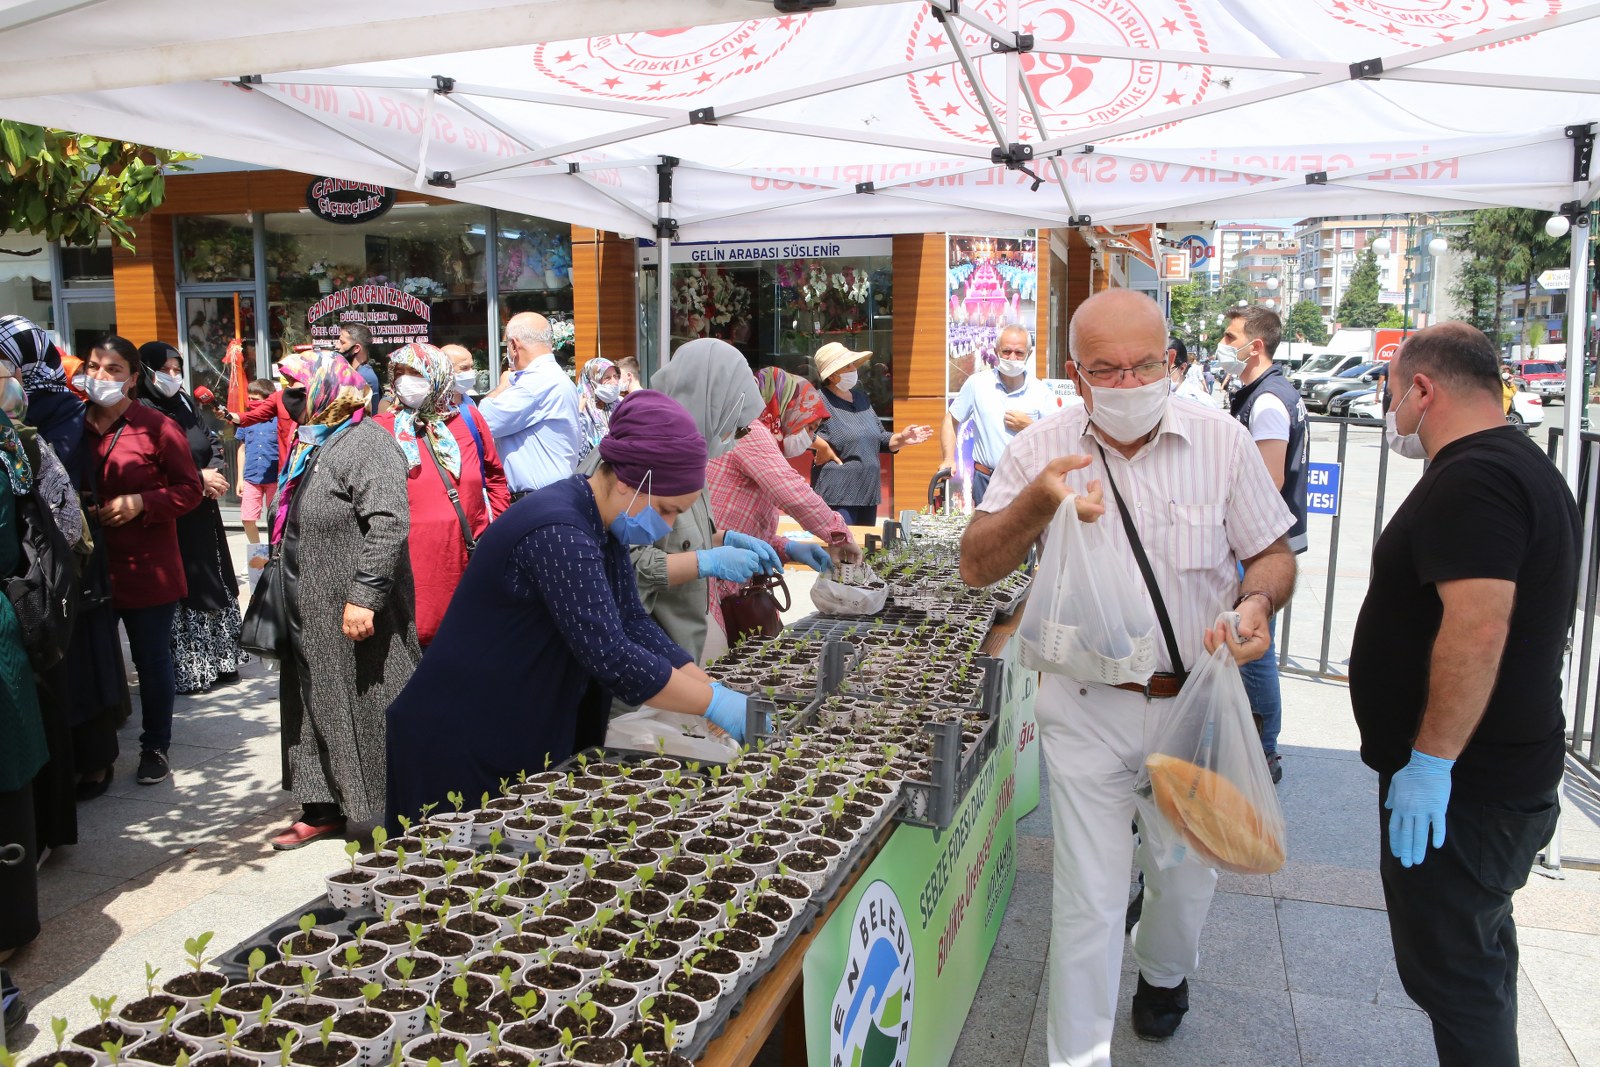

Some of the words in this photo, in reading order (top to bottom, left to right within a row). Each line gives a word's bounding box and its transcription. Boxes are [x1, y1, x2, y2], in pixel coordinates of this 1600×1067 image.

[312, 177, 386, 199] CANDAN
[318, 194, 381, 218] ÇİÇEKÇİLİK
[691, 246, 725, 262] GELİN
[729, 244, 780, 260] ARABASI
[783, 242, 841, 258] SÜSLENİR
[308, 288, 350, 323] CANDAN
[350, 282, 431, 322] ORGANİZASYON
[1308, 470, 1328, 486] EN
[919, 848, 949, 930] SEBZE
[948, 805, 972, 873] FİDESİ
[937, 893, 965, 979] Birlikte
